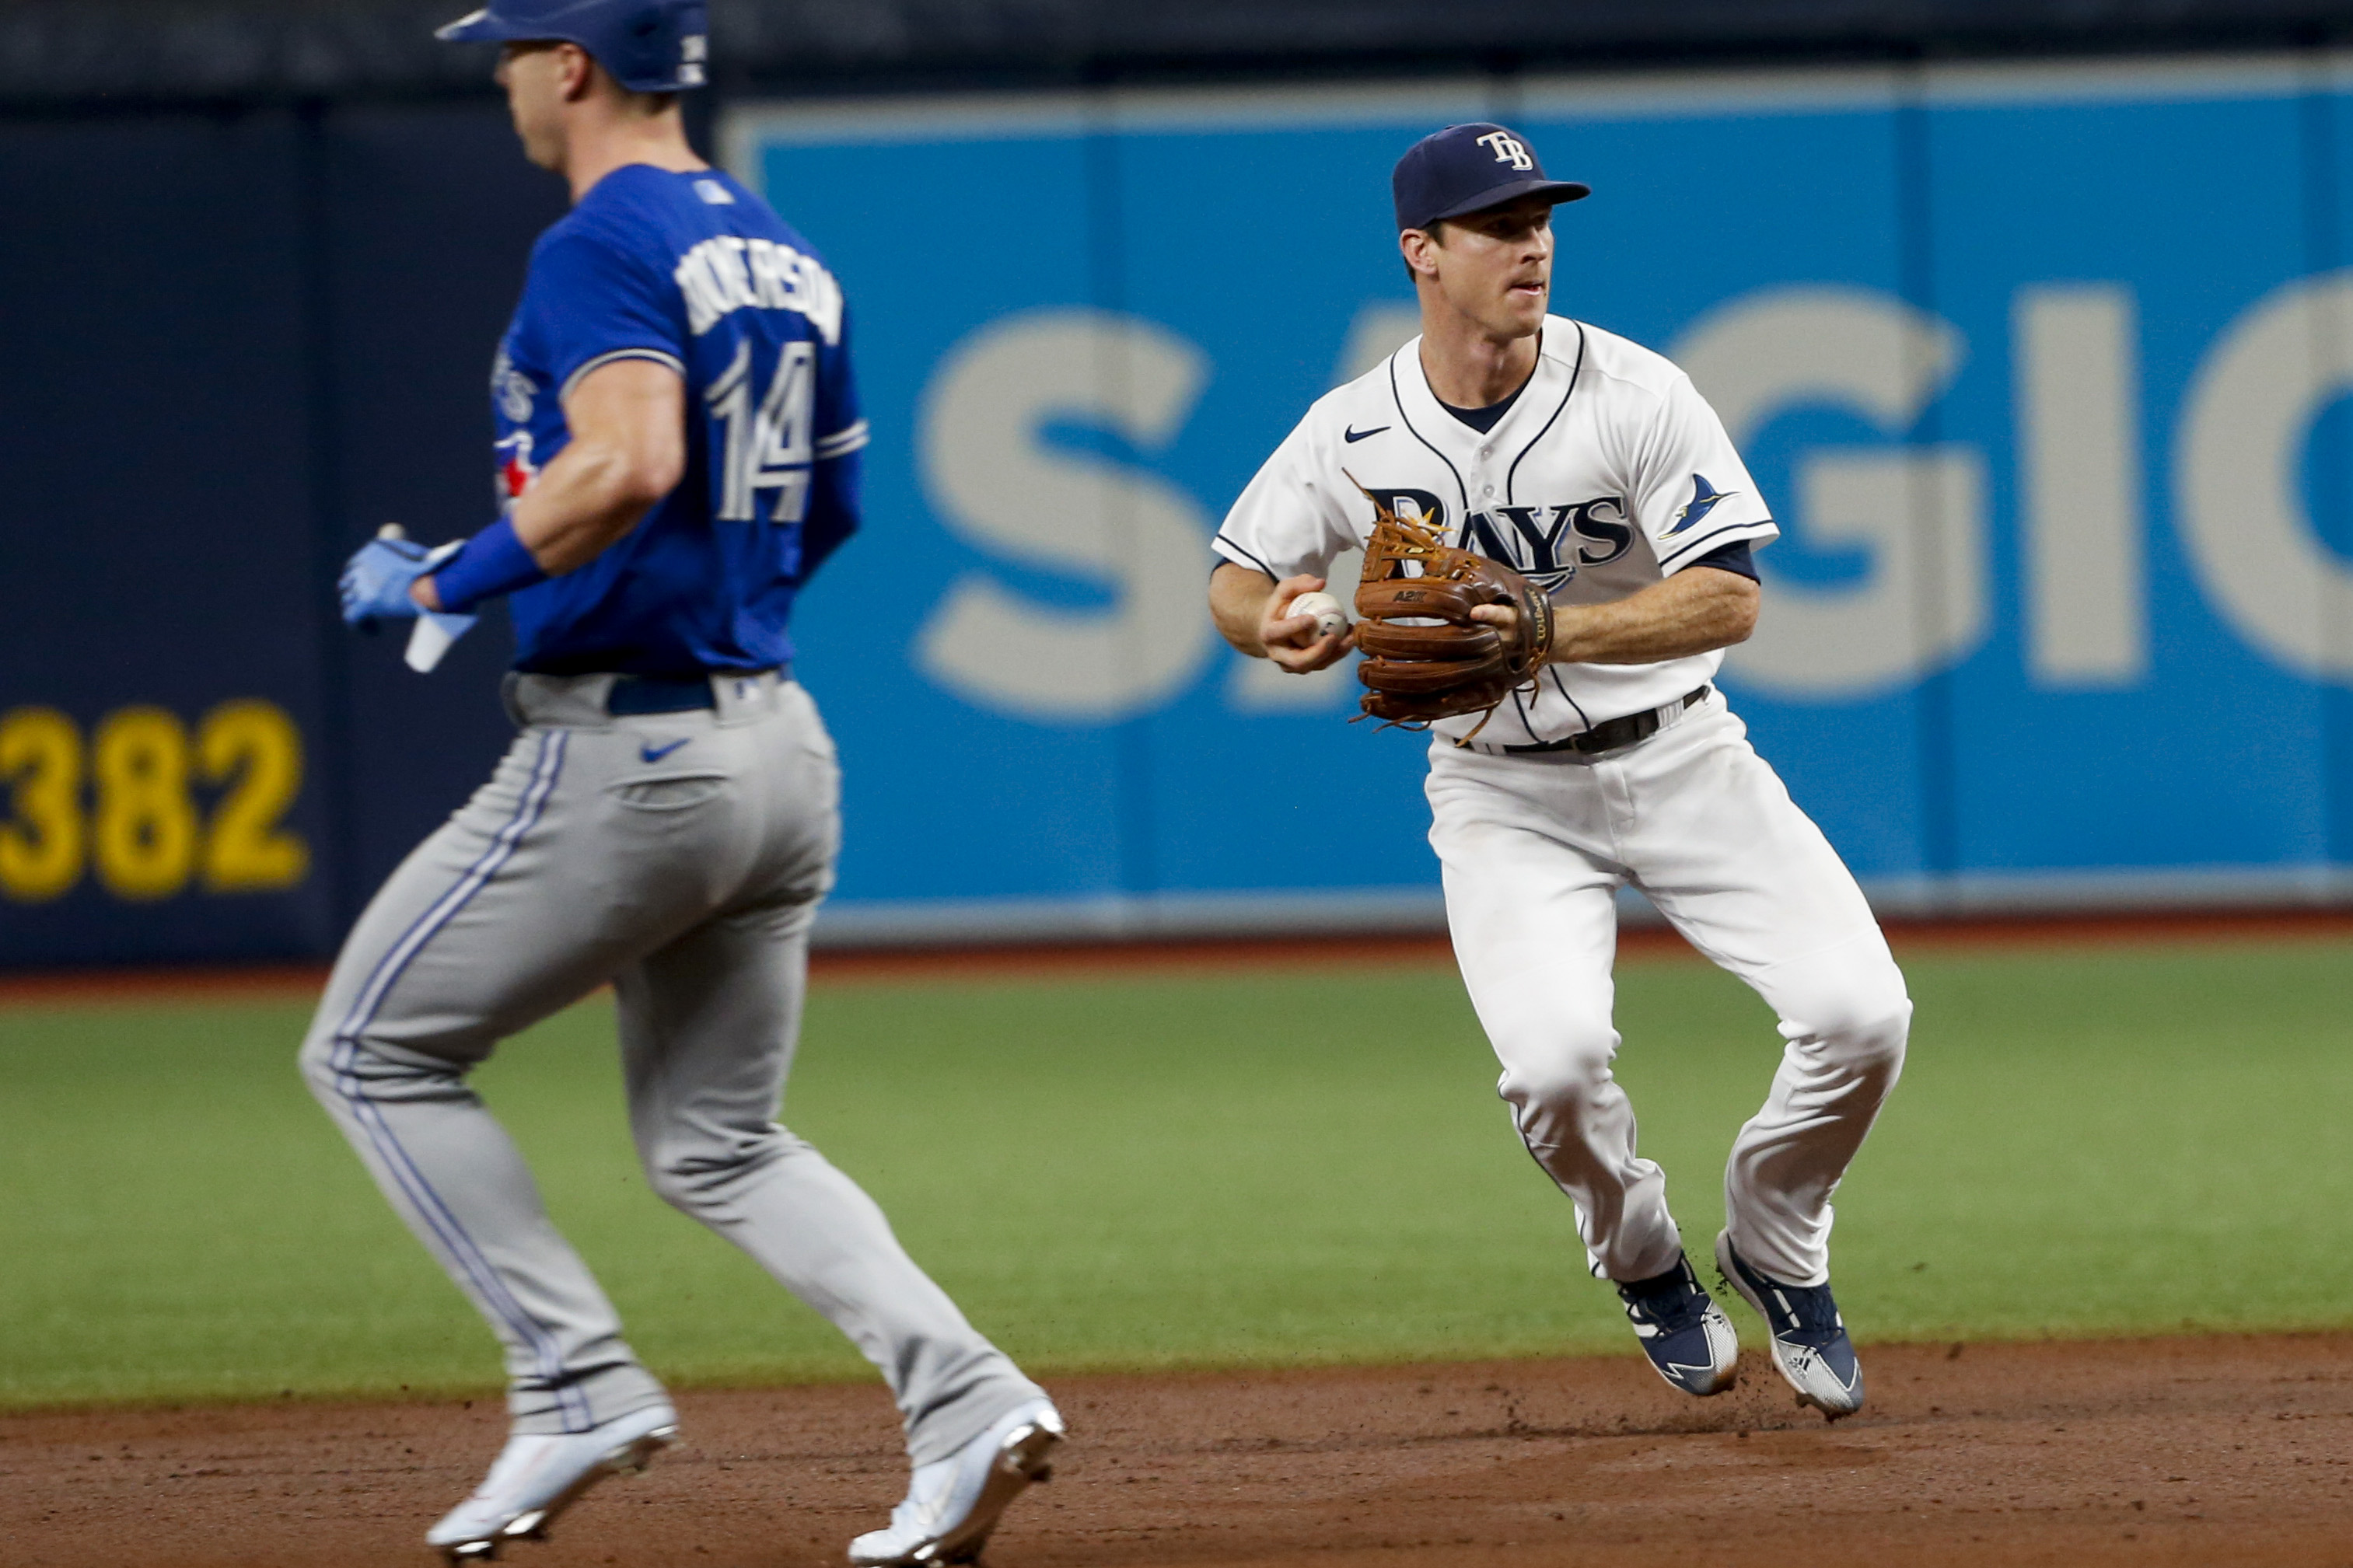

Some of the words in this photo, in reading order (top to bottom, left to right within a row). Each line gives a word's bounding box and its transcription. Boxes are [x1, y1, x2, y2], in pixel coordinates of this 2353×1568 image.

[1476, 131, 1534, 171] TB
[705, 338, 816, 522] 14
[911, 274, 2353, 723] SGI
[0, 702, 307, 900] 382
